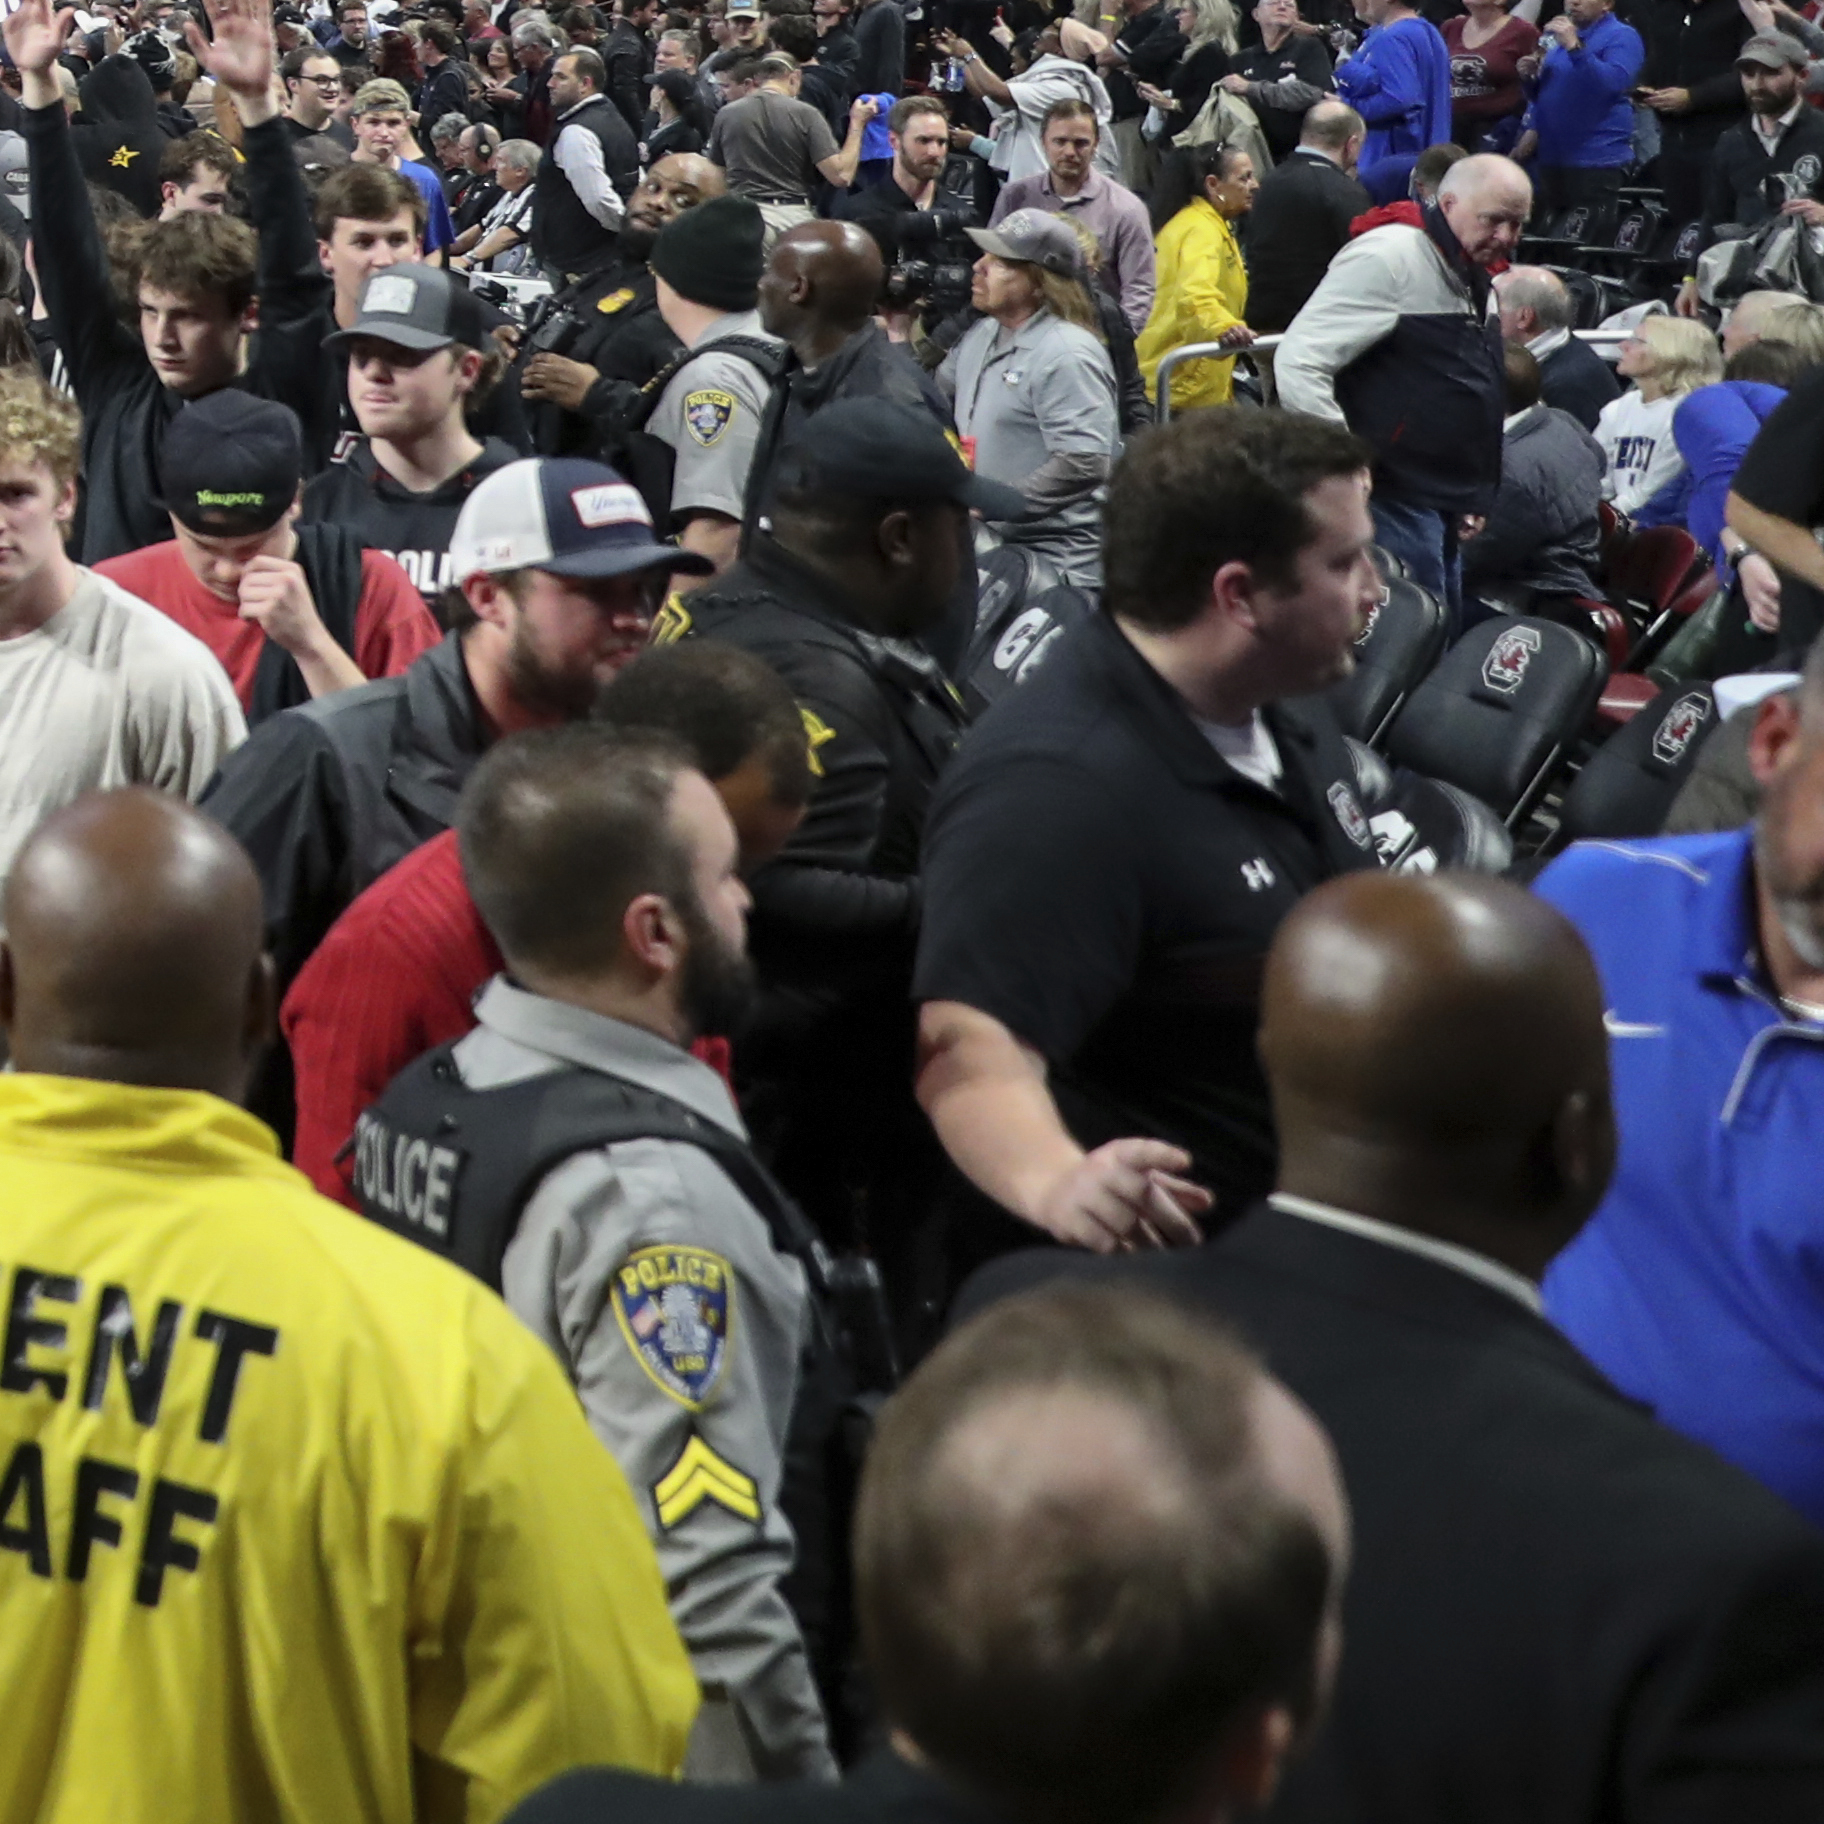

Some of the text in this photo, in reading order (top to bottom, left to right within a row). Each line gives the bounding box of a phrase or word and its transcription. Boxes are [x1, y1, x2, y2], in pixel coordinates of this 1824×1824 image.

[688, 392, 731, 408] POLICE
[196, 489, 264, 508] Newport
[353, 1111, 460, 1236] POLICE
[619, 1254, 720, 1297] POLICE
